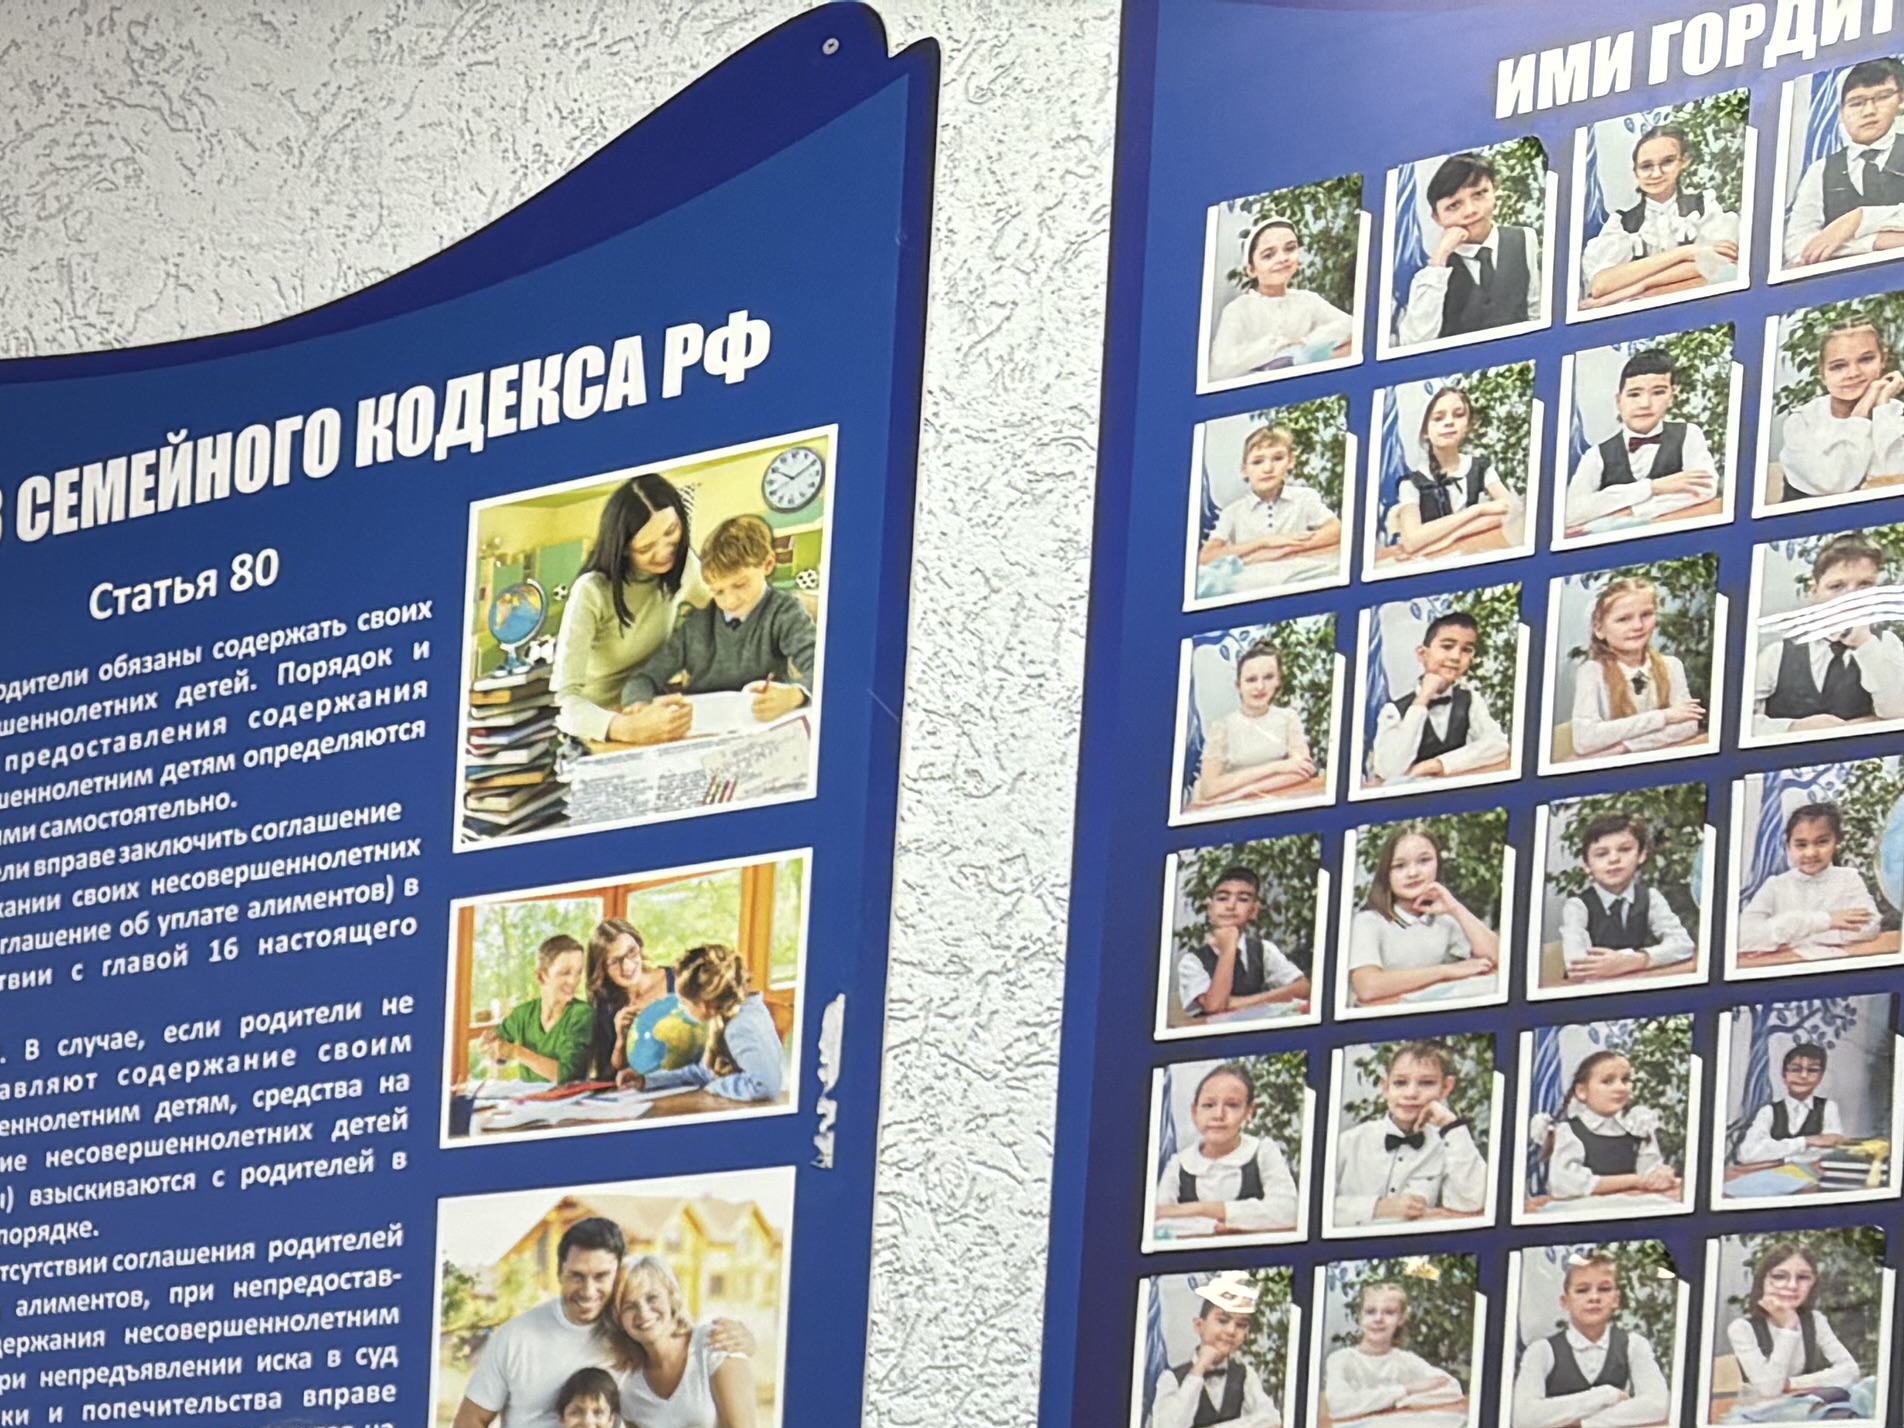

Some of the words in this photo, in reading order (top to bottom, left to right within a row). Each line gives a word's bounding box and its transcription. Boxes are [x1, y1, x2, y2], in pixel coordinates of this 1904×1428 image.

[1496, 31, 1634, 118] ИМИ
[17, 408, 340, 541] СЕМЕЙНОГО
[356, 336, 647, 466] КОДЕКСА
[663, 310, 770, 398] РФ
[90, 570, 217, 619] Статья
[231, 549, 278, 591] 80
[98, 646, 202, 681] обязаны
[212, 619, 348, 660] содержать
[357, 600, 433, 632] своих
[175, 668, 257, 709] детей.
[277, 647, 393, 686] Порядок
[413, 640, 430, 660] и
[5, 716, 227, 774] предоставления
[248, 680, 428, 729] содержания
[159, 753, 236, 787] детям
[243, 719, 426, 768] определяются
[34, 848, 116, 877] вправе
[119, 828, 248, 864] заключить
[251, 802, 402, 843] соглашение
[39, 792, 237, 839] самостоятельно.
[72, 881, 140, 907] своих
[151, 837, 421, 896] несовершеннолетних
[119, 910, 150, 938] об
[157, 904, 239, 937] уплате
[247, 874, 395, 919] алиментов)
[404, 877, 419, 897] в
[71, 963, 83, 981] с
[102, 942, 188, 977] главой
[209, 936, 239, 963] 16
[258, 916, 418, 956] настоящего
[25, 1038, 40, 1061] В
[57, 1030, 145, 1058] случае,
[164, 1019, 221, 1043] если
[240, 1002, 362, 1039] родители
[382, 995, 414, 1016] не
[117, 1048, 297, 1087] содержание
[318, 1034, 412, 1062] своим
[154, 1094, 237, 1124] детям,
[252, 1078, 363, 1112] средства
[379, 1073, 410, 1094] на
[45, 1122, 313, 1168] несовершеннолетних
[331, 1105, 409, 1143] детей
[30, 1172, 196, 1206] взыскиваются
[212, 1169, 225, 1188] с
[240, 1148, 375, 1190] родителей
[392, 1151, 408, 1170] в
[112, 1242, 256, 1272] соглашения
[268, 1222, 404, 1263] родителей
[15, 1290, 150, 1317] алиментов,
[169, 1283, 214, 1308] при
[233, 1268, 402, 1300] непредостав-
[124, 1307, 400, 1345] несовершеннолетним
[39, 1356, 243, 1390] непредъявлении
[257, 1351, 312, 1372] иска
[327, 1349, 341, 1368] в
[355, 1345, 399, 1370] суд
[48, 1406, 63, 1423] и
[82, 1391, 282, 1421] попечительства
[303, 1384, 397, 1408] вправе
